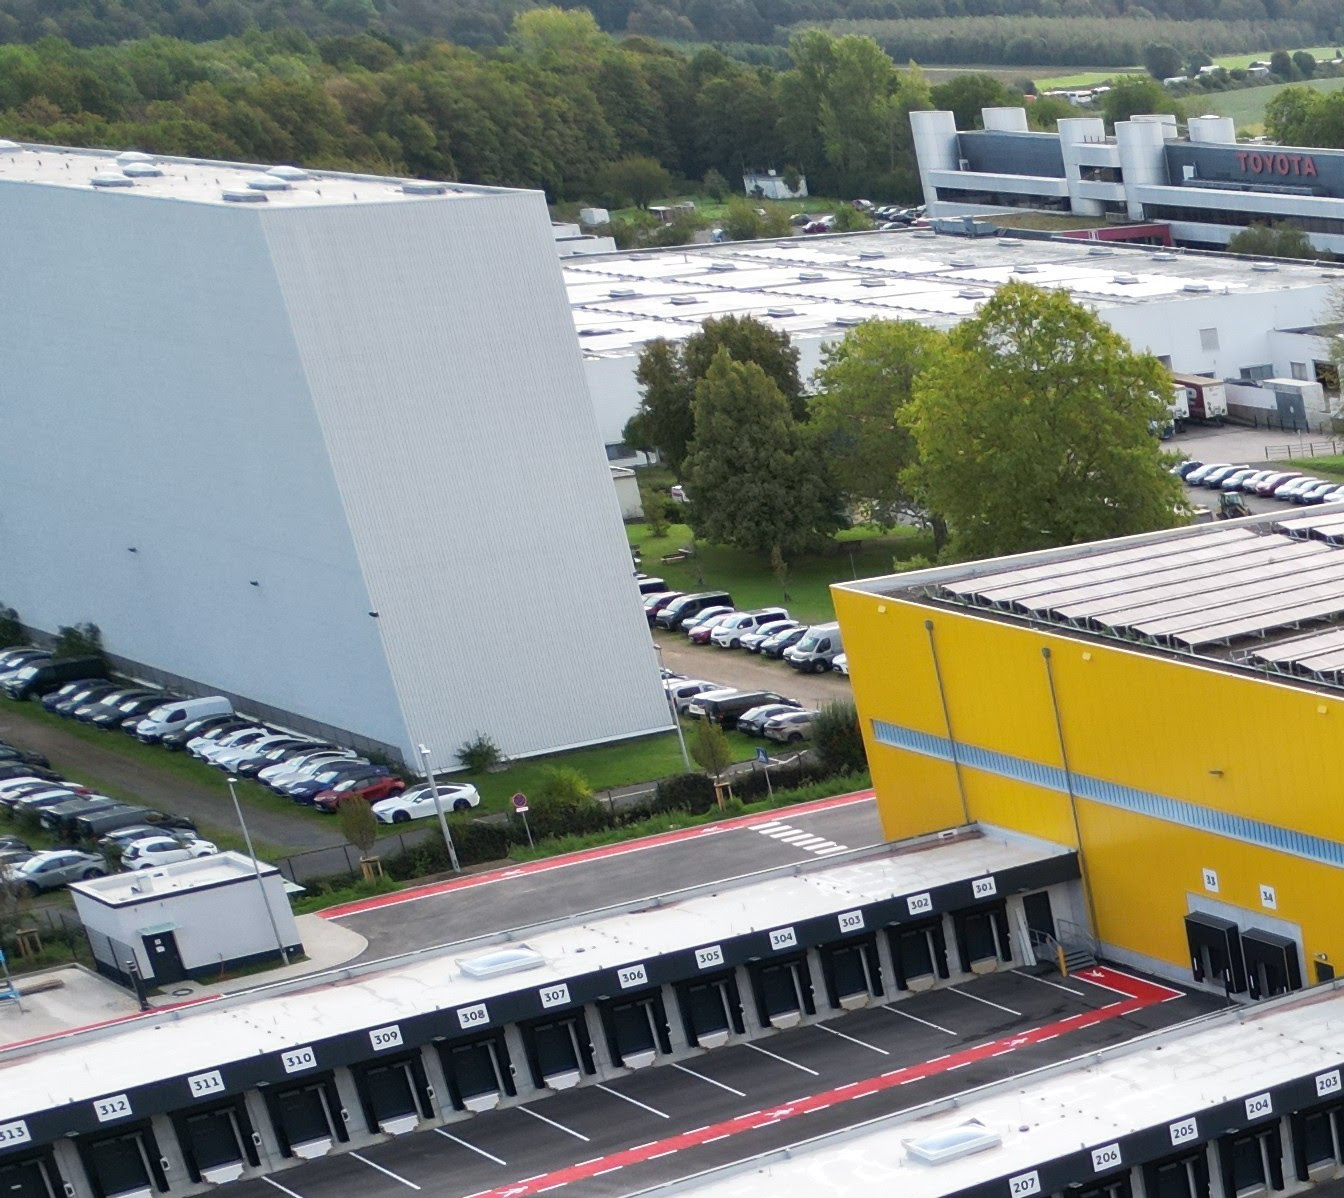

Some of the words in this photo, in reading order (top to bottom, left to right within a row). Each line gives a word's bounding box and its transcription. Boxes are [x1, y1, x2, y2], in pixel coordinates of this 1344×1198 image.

[1236, 152, 1318, 177] TOYOTA
[975, 882, 994, 894] 301
[911, 898, 929, 910] 302
[841, 915, 861, 928] 303
[773, 932, 793, 945] 304
[699, 950, 720, 964] 305
[622, 970, 644, 983] 306
[544, 988, 565, 1003] 307
[462, 1009, 485, 1023] 308
[374, 1031, 398, 1045] 309
[286, 1052, 312, 1067] 310
[193, 1076, 220, 1091] 311
[1319, 1076, 1338, 1091] 203
[99, 1100, 127, 1116] 312
[1248, 1099, 1269, 1114] 204
[1173, 1124, 1194, 1139] 205
[1095, 1150, 1118, 1166] 206
[1013, 1177, 1035, 1194] 207
